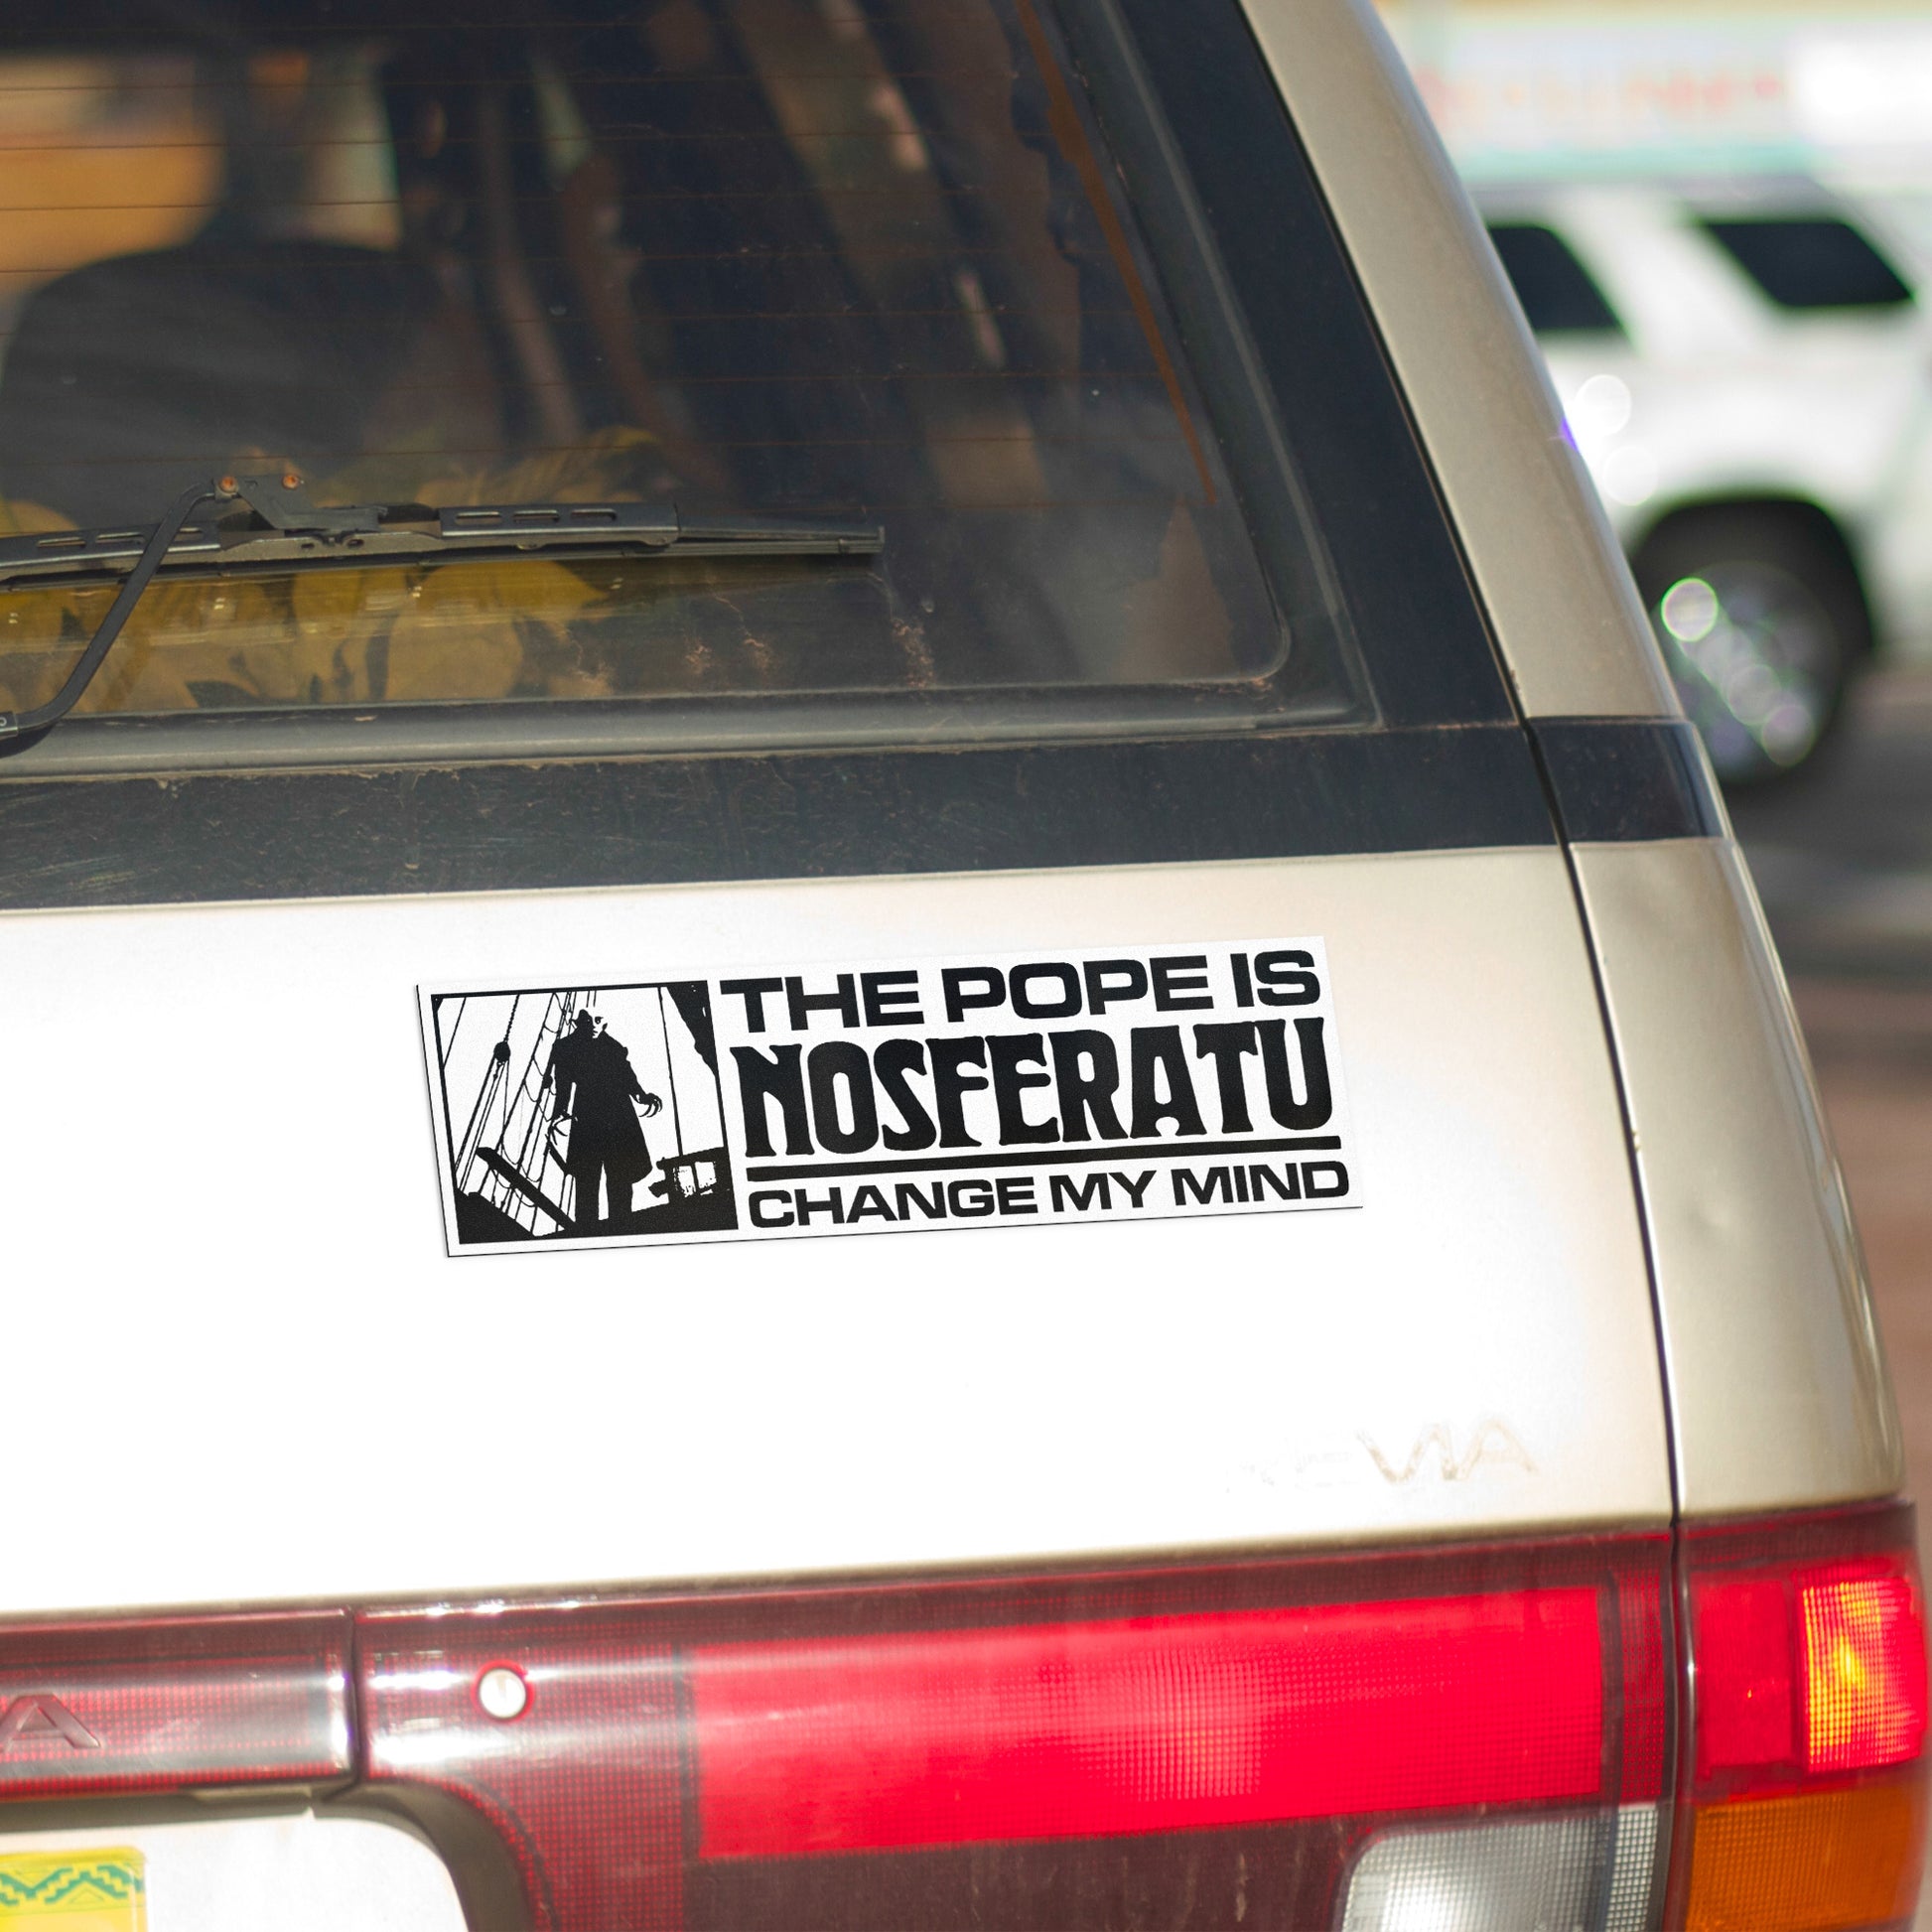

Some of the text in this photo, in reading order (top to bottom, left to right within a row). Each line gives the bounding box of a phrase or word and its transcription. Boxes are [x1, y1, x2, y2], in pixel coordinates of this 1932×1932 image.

[720, 950, 1320, 1033] THE POPE IS
[730, 1018, 1333, 1158] NOSFERATU
[749, 1161, 1349, 1228] CHANGE MY MIND
